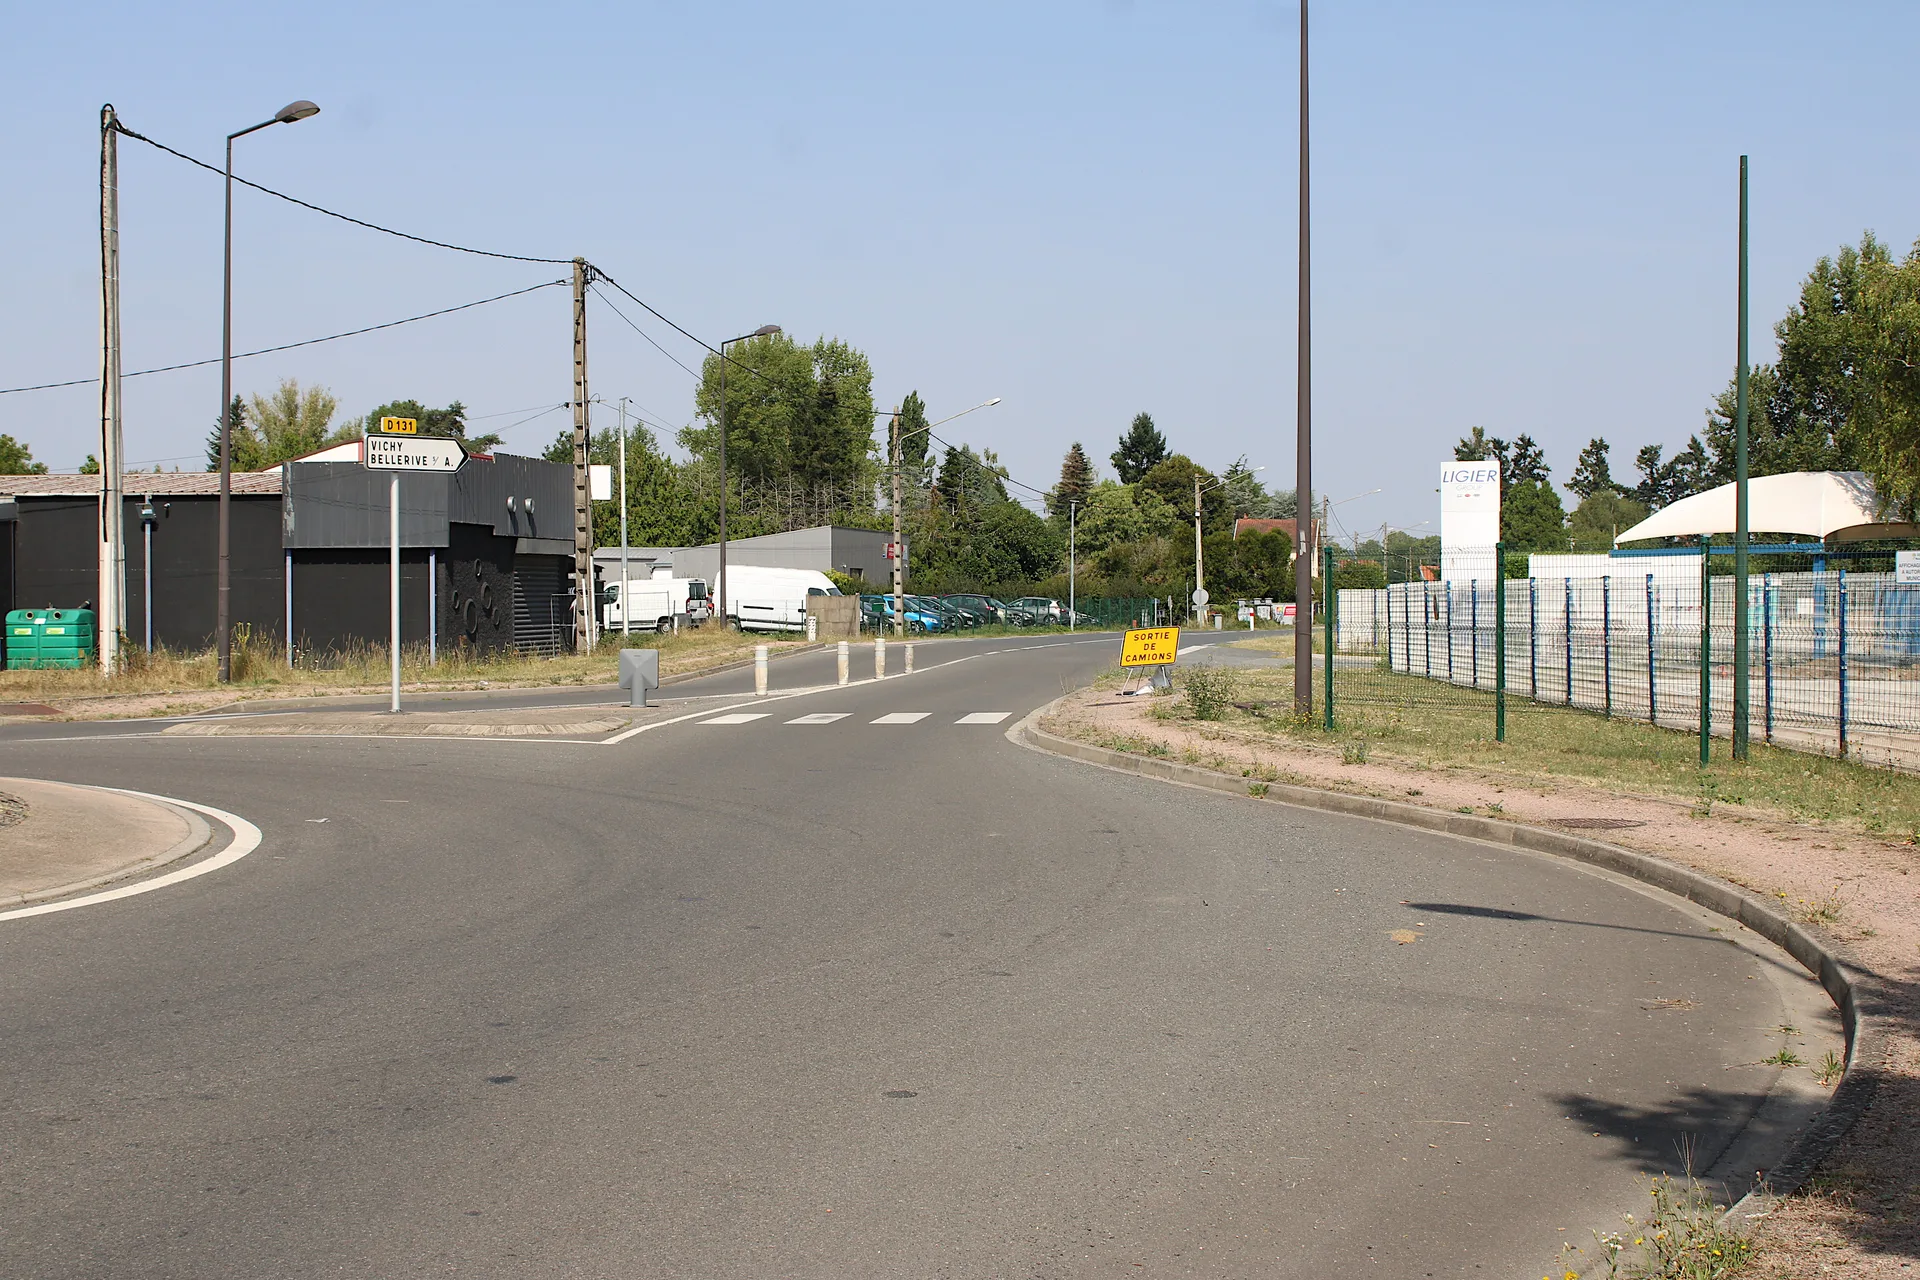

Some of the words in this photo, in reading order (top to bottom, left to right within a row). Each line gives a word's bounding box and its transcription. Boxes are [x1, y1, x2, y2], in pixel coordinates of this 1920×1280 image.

[387, 419, 394, 430] D
[396, 420, 413, 431] 131
[371, 440, 403, 452] VICHY
[371, 453, 428, 466] BELLERIVE
[444, 456, 454, 467] A.
[1443, 470, 1497, 482] LIGIER
[1134, 632, 1169, 641] SORTIE
[1143, 643, 1156, 651] DE
[1125, 653, 1172, 662] CAMIONS
